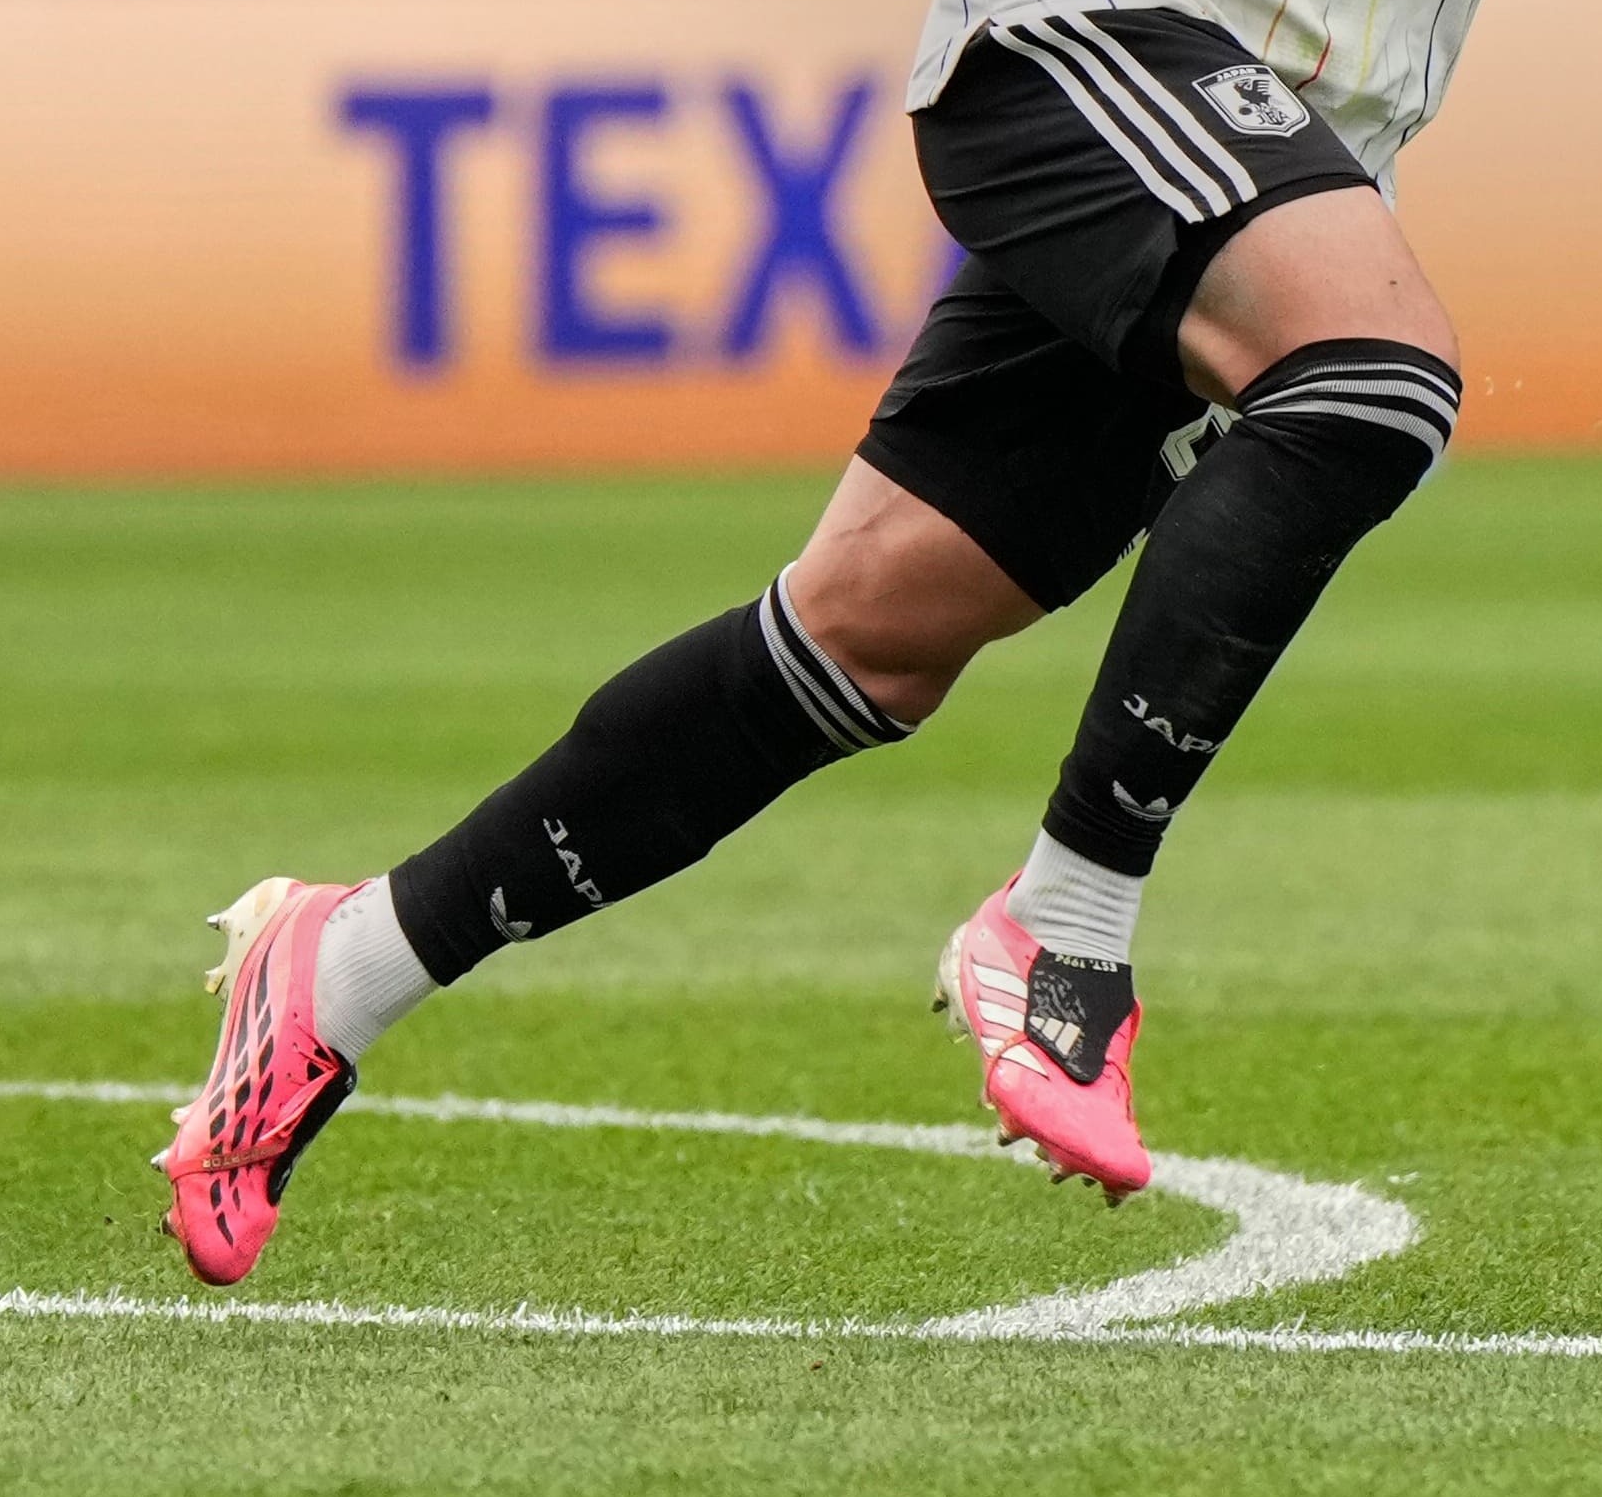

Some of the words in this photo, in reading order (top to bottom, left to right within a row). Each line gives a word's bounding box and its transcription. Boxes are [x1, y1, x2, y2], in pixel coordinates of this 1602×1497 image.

[1216, 67, 1257, 82] JAPAN
[336, 81, 968, 369] TEX
[1122, 693, 1223, 754] JAP
[543, 817, 616, 908] JAP
